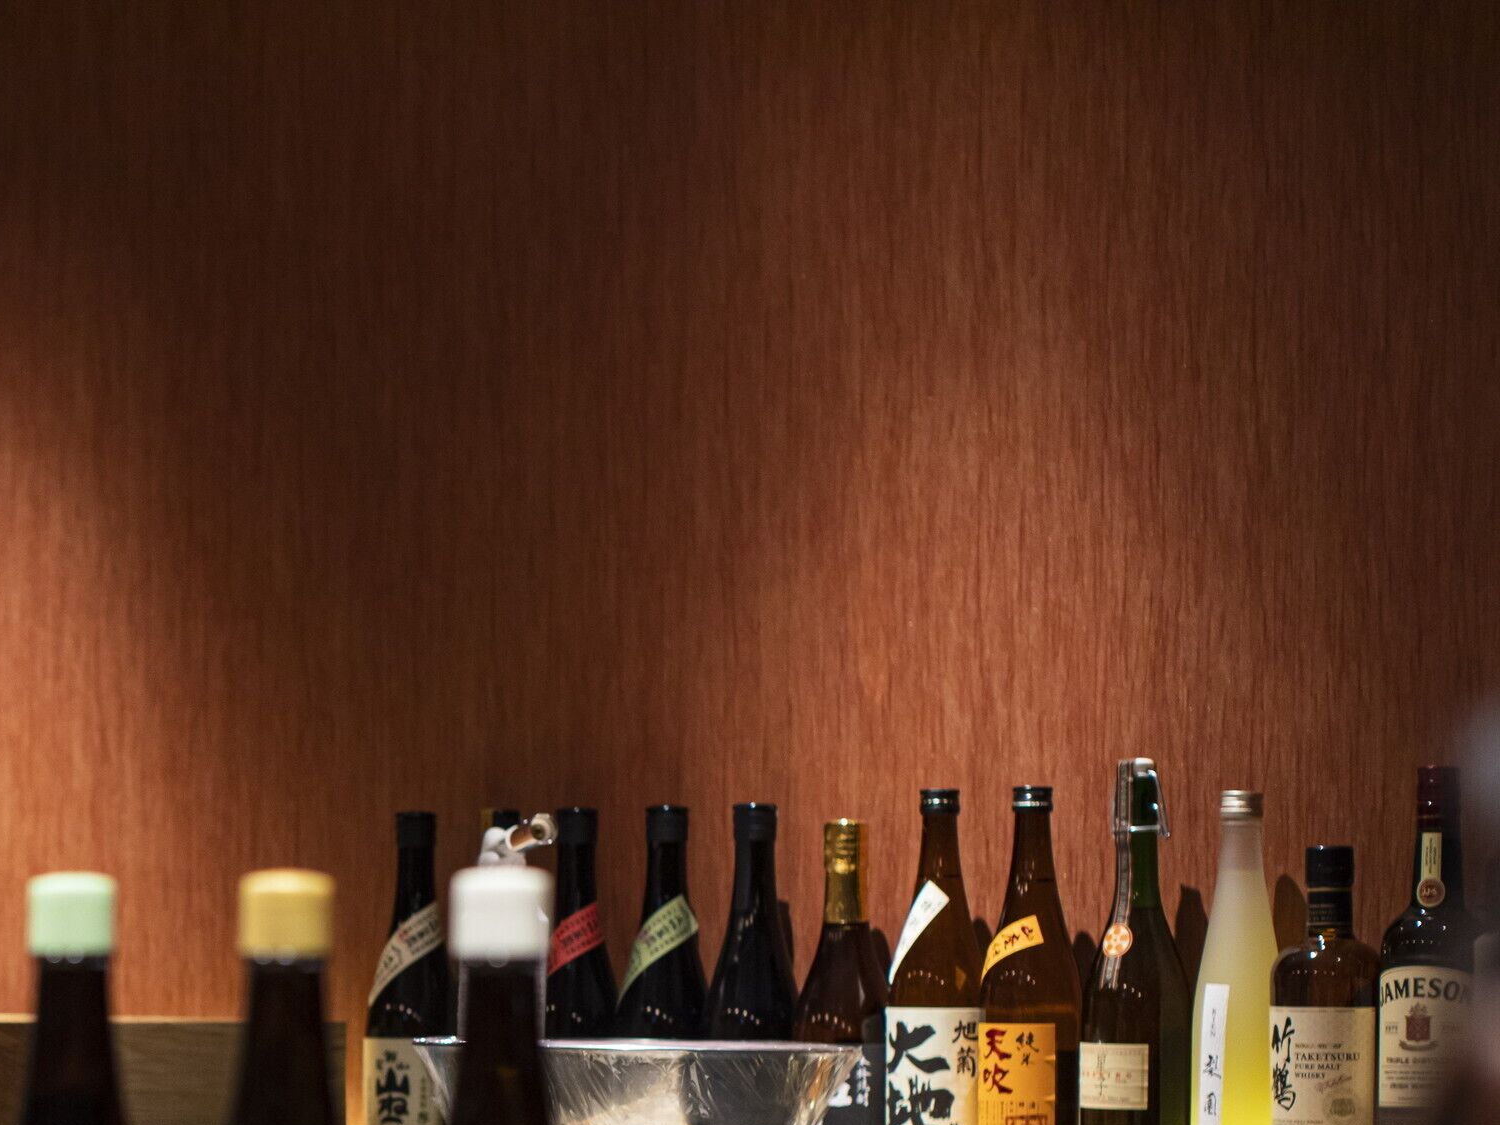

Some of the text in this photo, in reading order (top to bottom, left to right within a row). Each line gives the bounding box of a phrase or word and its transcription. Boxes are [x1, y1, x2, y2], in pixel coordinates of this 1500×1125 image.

[982, 1028, 1013, 1095] 天吹
[1295, 1052, 1360, 1062] TAKETSURU
[1295, 1062, 1342, 1071] PURE MALT
[1295, 1072, 1326, 1080] WHISKY
